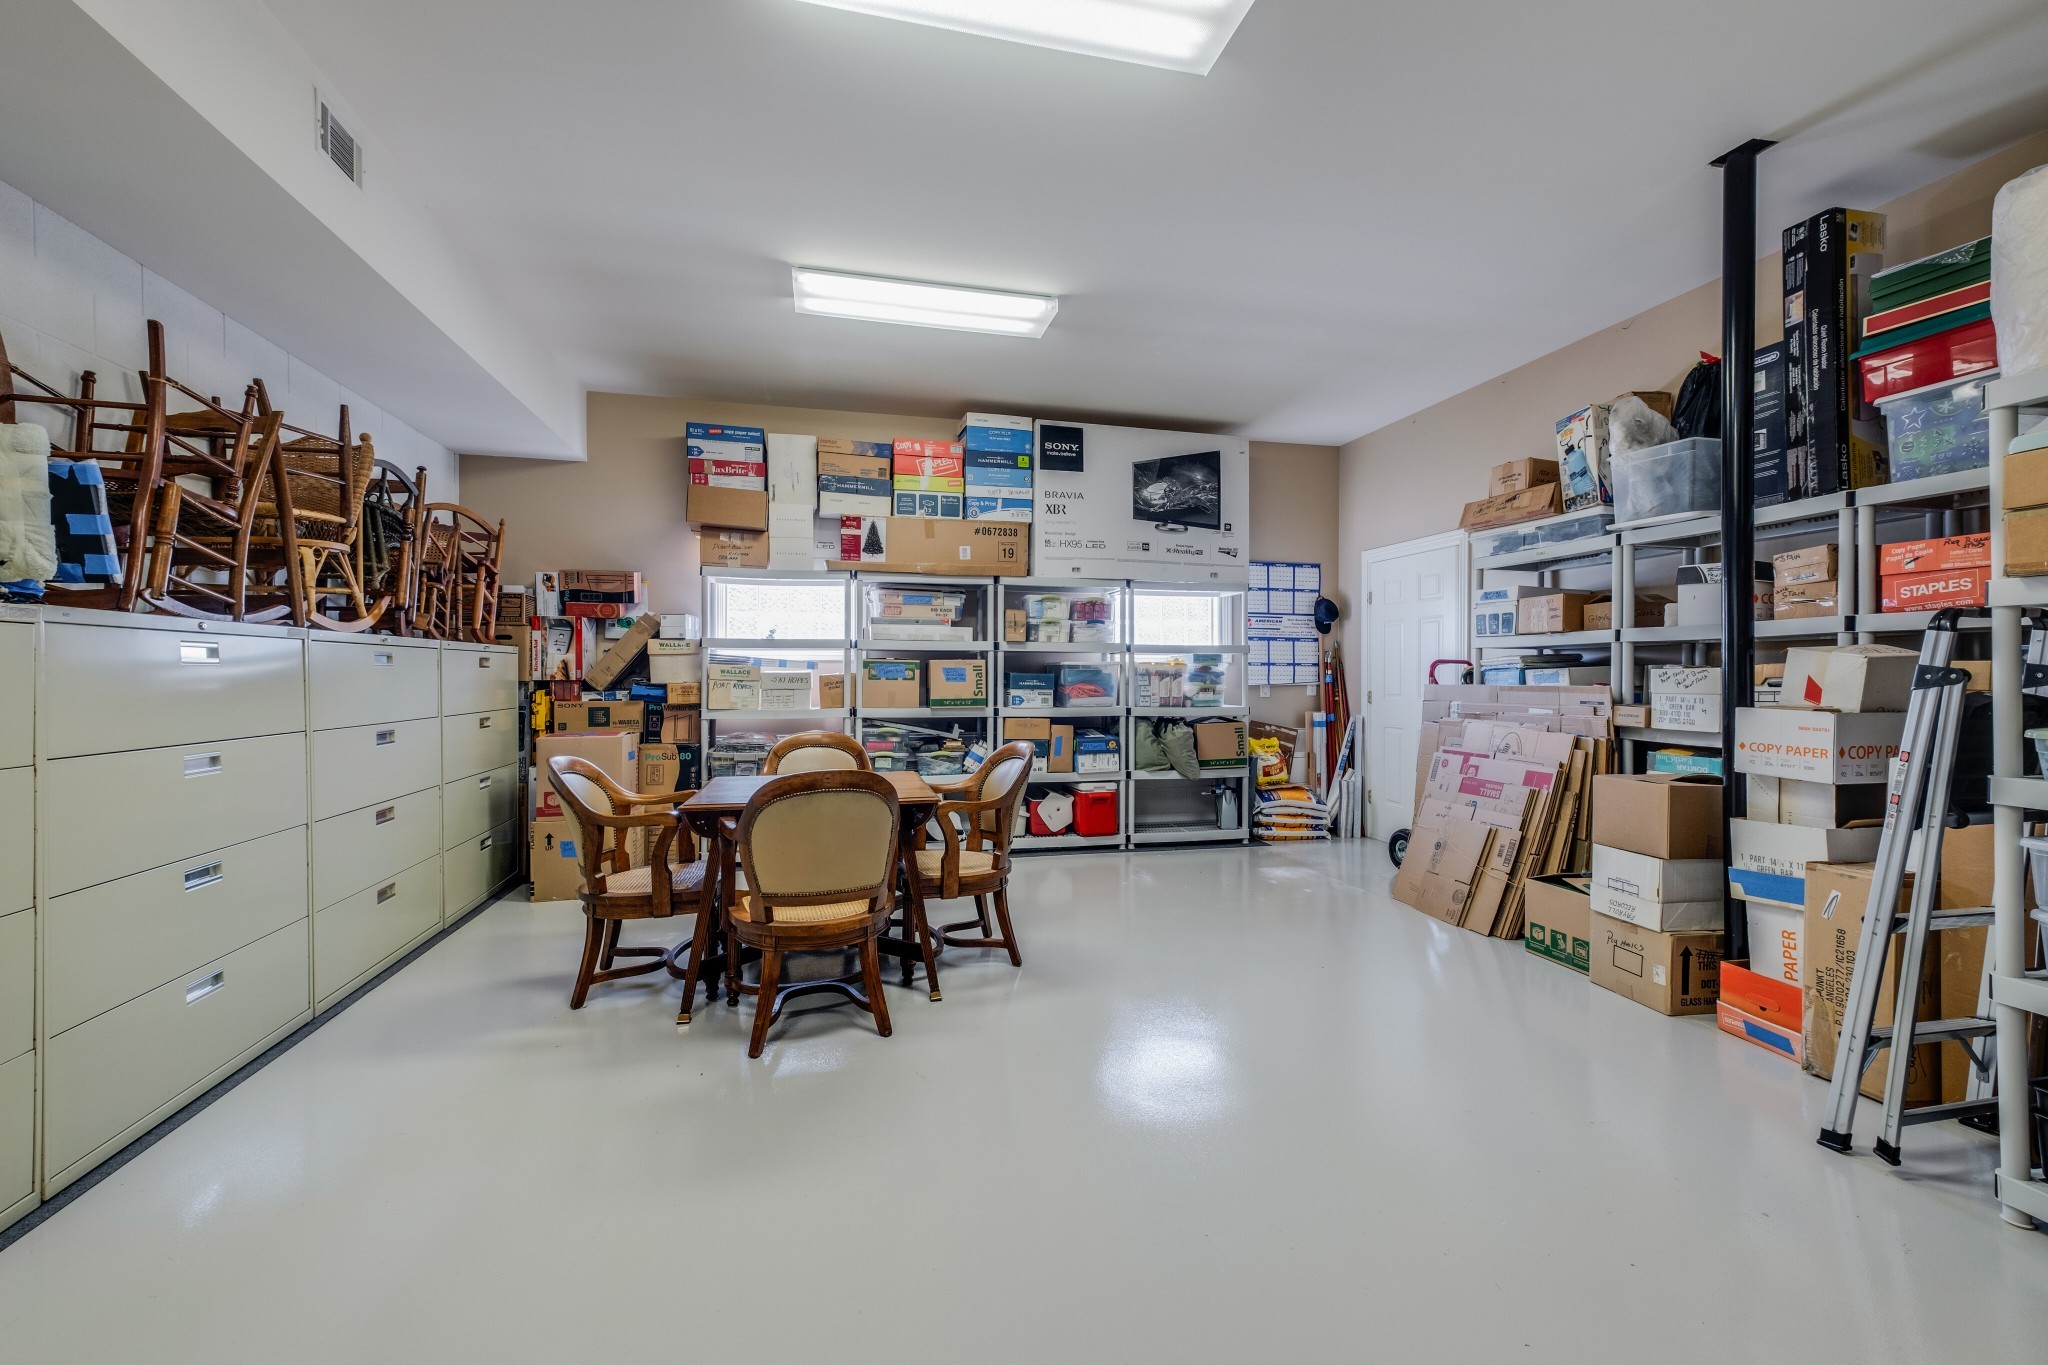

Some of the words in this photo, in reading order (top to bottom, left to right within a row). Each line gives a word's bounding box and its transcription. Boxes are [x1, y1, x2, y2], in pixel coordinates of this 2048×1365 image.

[1820, 214, 1829, 252] Lasko
[1841, 444, 1849, 489] Lasko
[1044, 491, 1084, 500] BRAVIA
[1045, 503, 1067, 515] XBR
[974, 526, 1018, 538] #0672838
[1060, 539, 1082, 549] HX95
[1891, 547, 1906, 556] Copy
[1906, 543, 1926, 552] Paper
[1002, 548, 1014, 559] 19
[1886, 554, 1904, 562] Papel
[1914, 548, 1934, 556] Copia
[1900, 577, 1972, 599] STAPLES
[1904, 599, 1974, 612] www.staples.com
[973, 665, 983, 697] Small
[1234, 727, 1245, 757] Small
[679, 752, 692, 760] 80
[1749, 743, 1782, 755] COPY
[1786, 745, 1829, 759] PAPER
[1848, 745, 1882, 759] COPY
[1677, 764, 1709, 773] DOMTAR
[1480, 787, 1501, 799] SMALL
[1750, 854, 1765, 864] PART
[1788, 860, 1793, 869] X
[1796, 862, 1804, 871] 11
[1756, 866, 1776, 875] GREEN
[1609, 899, 1636, 913] RECORDS
[1781, 929, 1798, 982] PAPER
[1697, 961, 1717, 971] THIS
[1815, 968, 1825, 1000] PUNKT
[1825, 967, 1835, 1003] ANGELES
[1680, 997, 1702, 1007] GLASS
